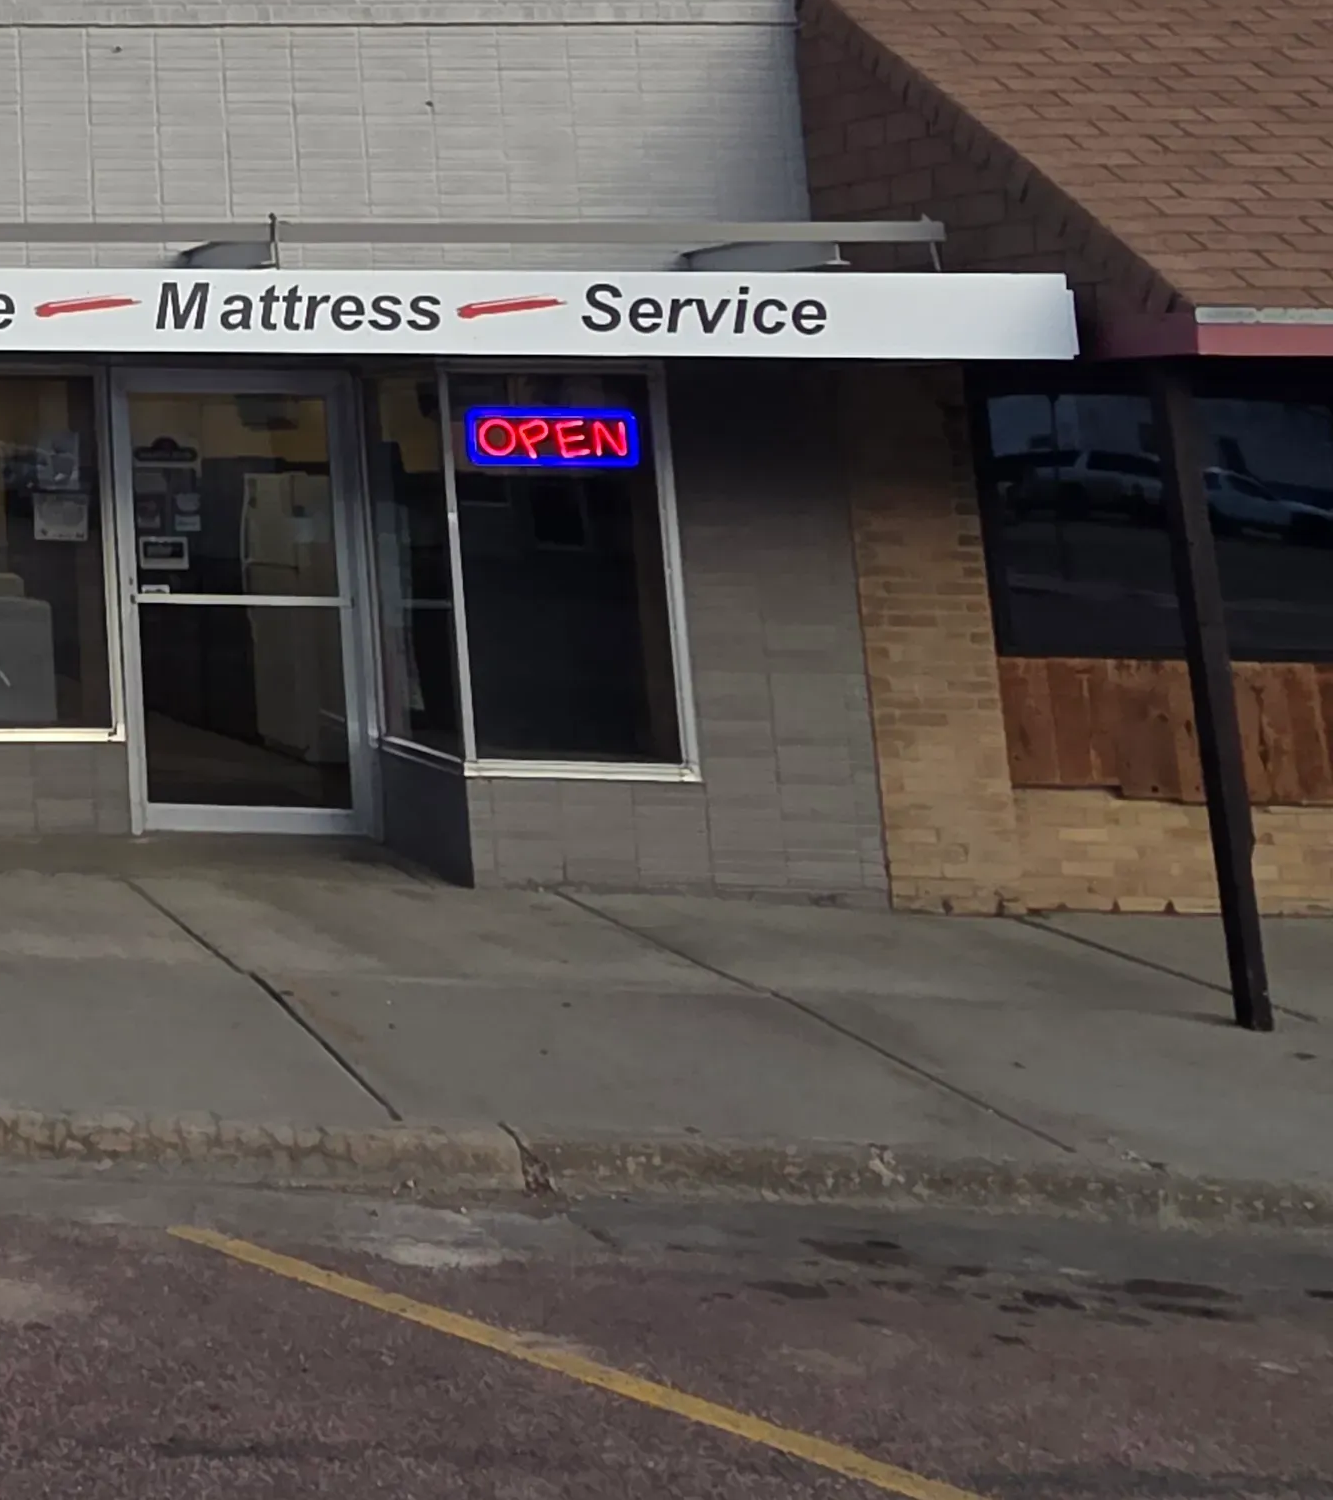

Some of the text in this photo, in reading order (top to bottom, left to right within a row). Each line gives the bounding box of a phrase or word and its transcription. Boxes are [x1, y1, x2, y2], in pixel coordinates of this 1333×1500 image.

[155, 282, 441, 332] Mattress
[581, 283, 828, 336] Service
[478, 417, 628, 460] OPEN
